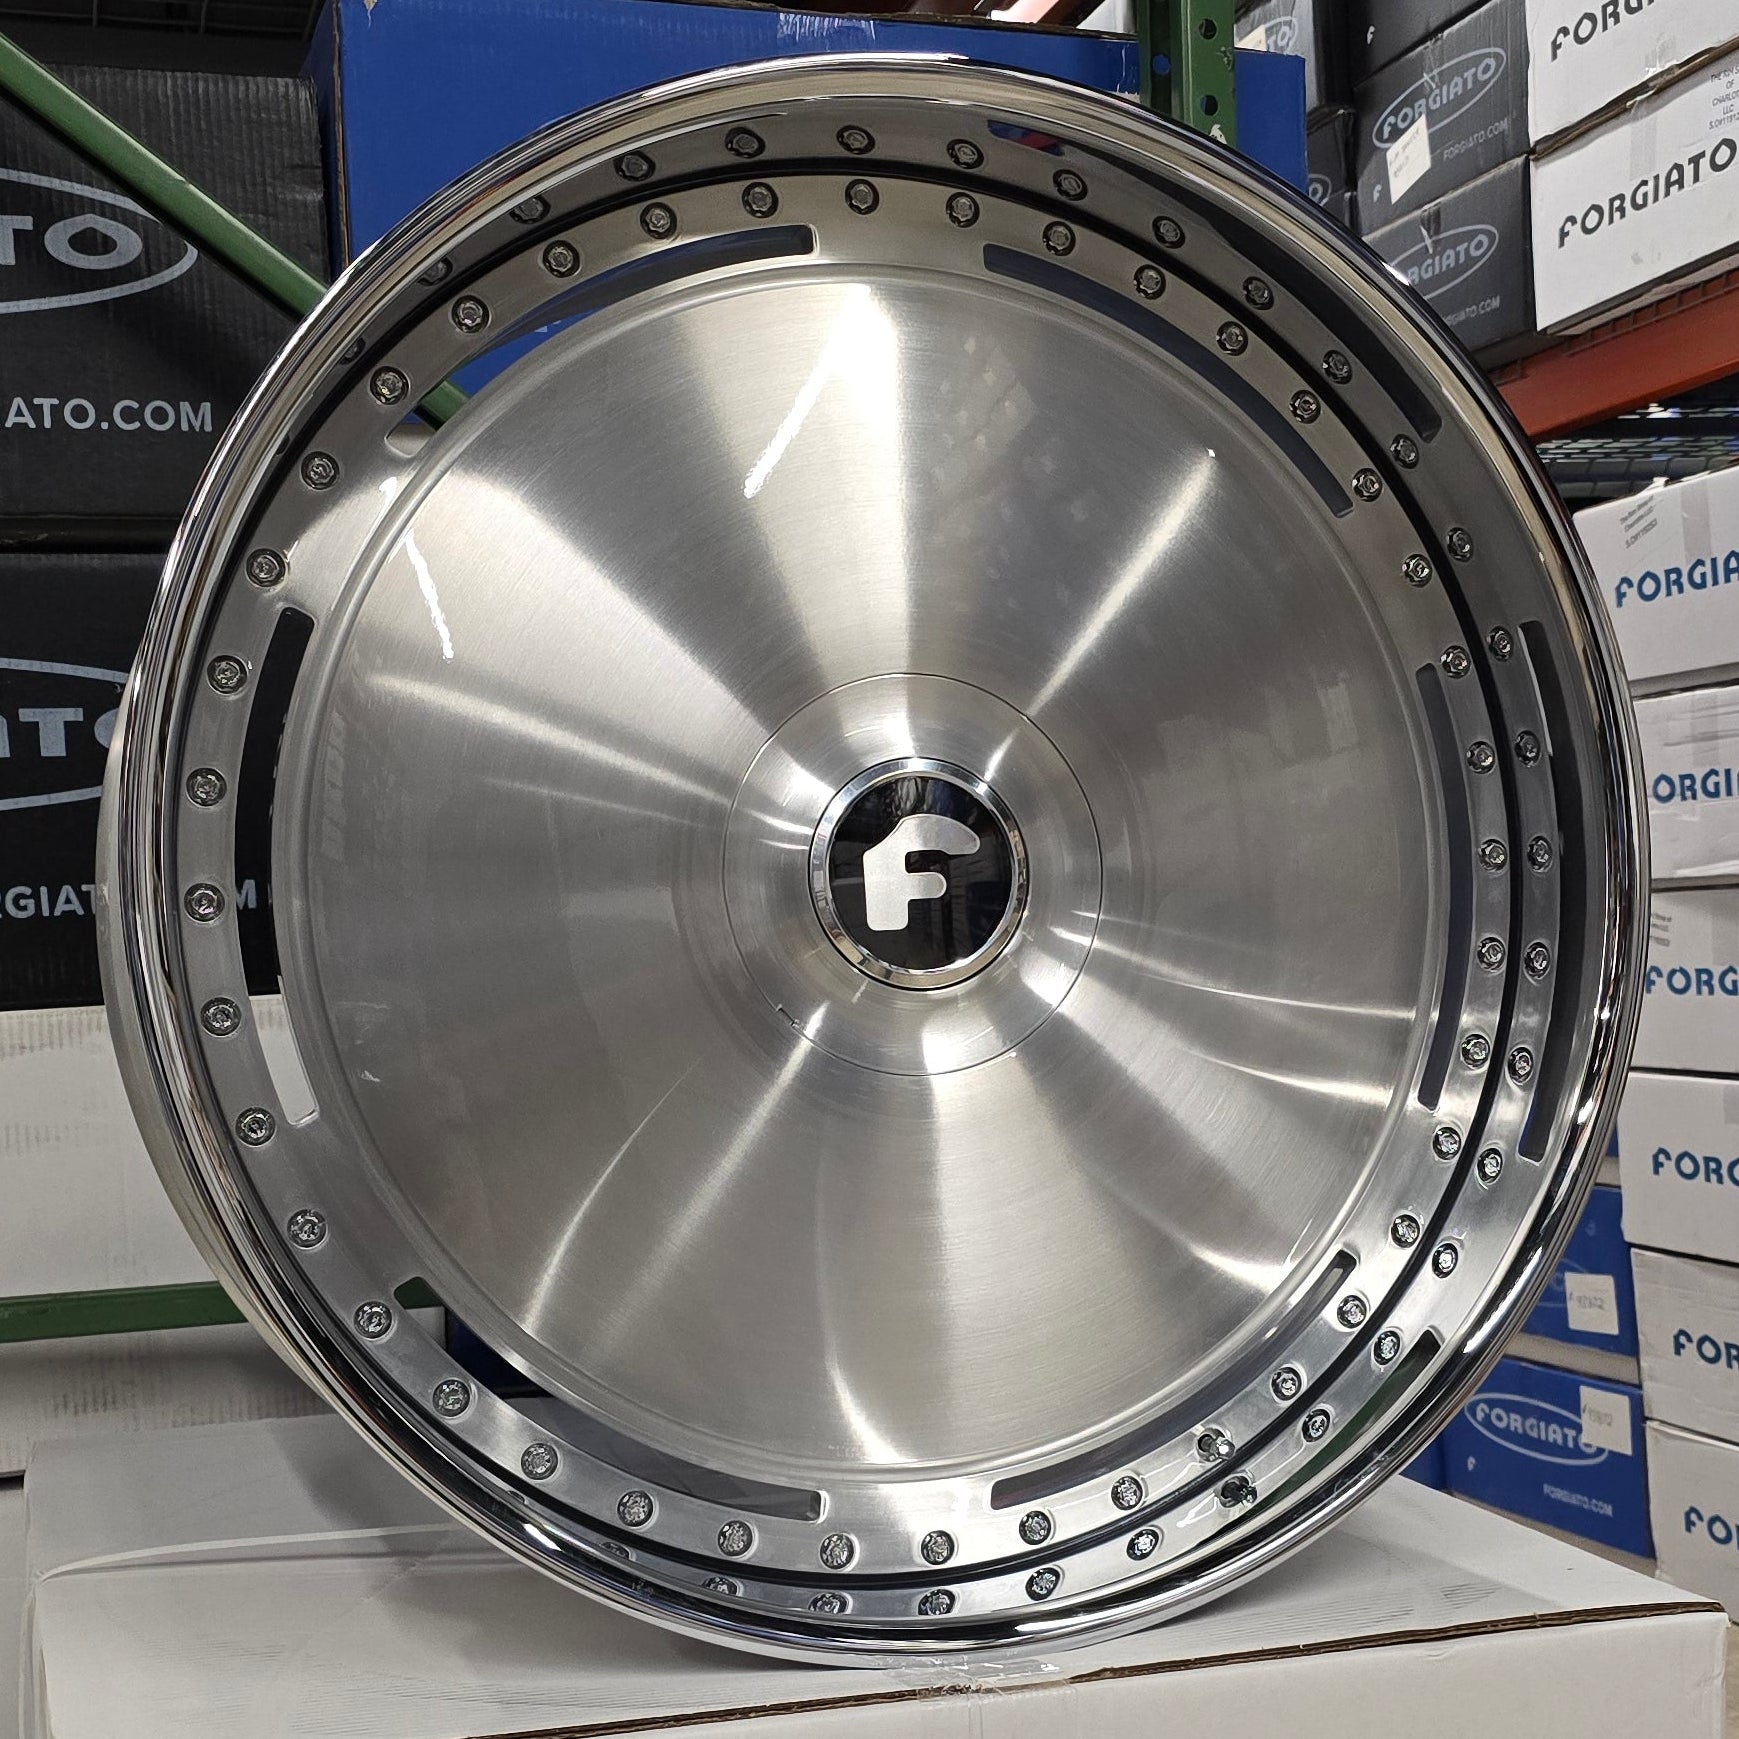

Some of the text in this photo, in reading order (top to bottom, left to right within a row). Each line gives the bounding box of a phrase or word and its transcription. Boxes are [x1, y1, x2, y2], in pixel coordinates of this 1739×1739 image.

[1549, 0, 1655, 62] FOR
[1382, 57, 1496, 140] FORGIATO
[1443, 116, 1510, 161] FORGIATO.COM
[1558, 138, 1738, 249] FORGIATO
[4, 396, 213, 433] ATO.COM
[1615, 549, 1739, 608] FORGIA
[1651, 767, 1739, 804] ORGI
[1645, 965, 1739, 996] FORG
[1673, 1328, 1739, 1370] FOR
[1542, 1483, 1614, 1518] FORGIATO.COM
[1684, 1505, 1739, 1551] FO
